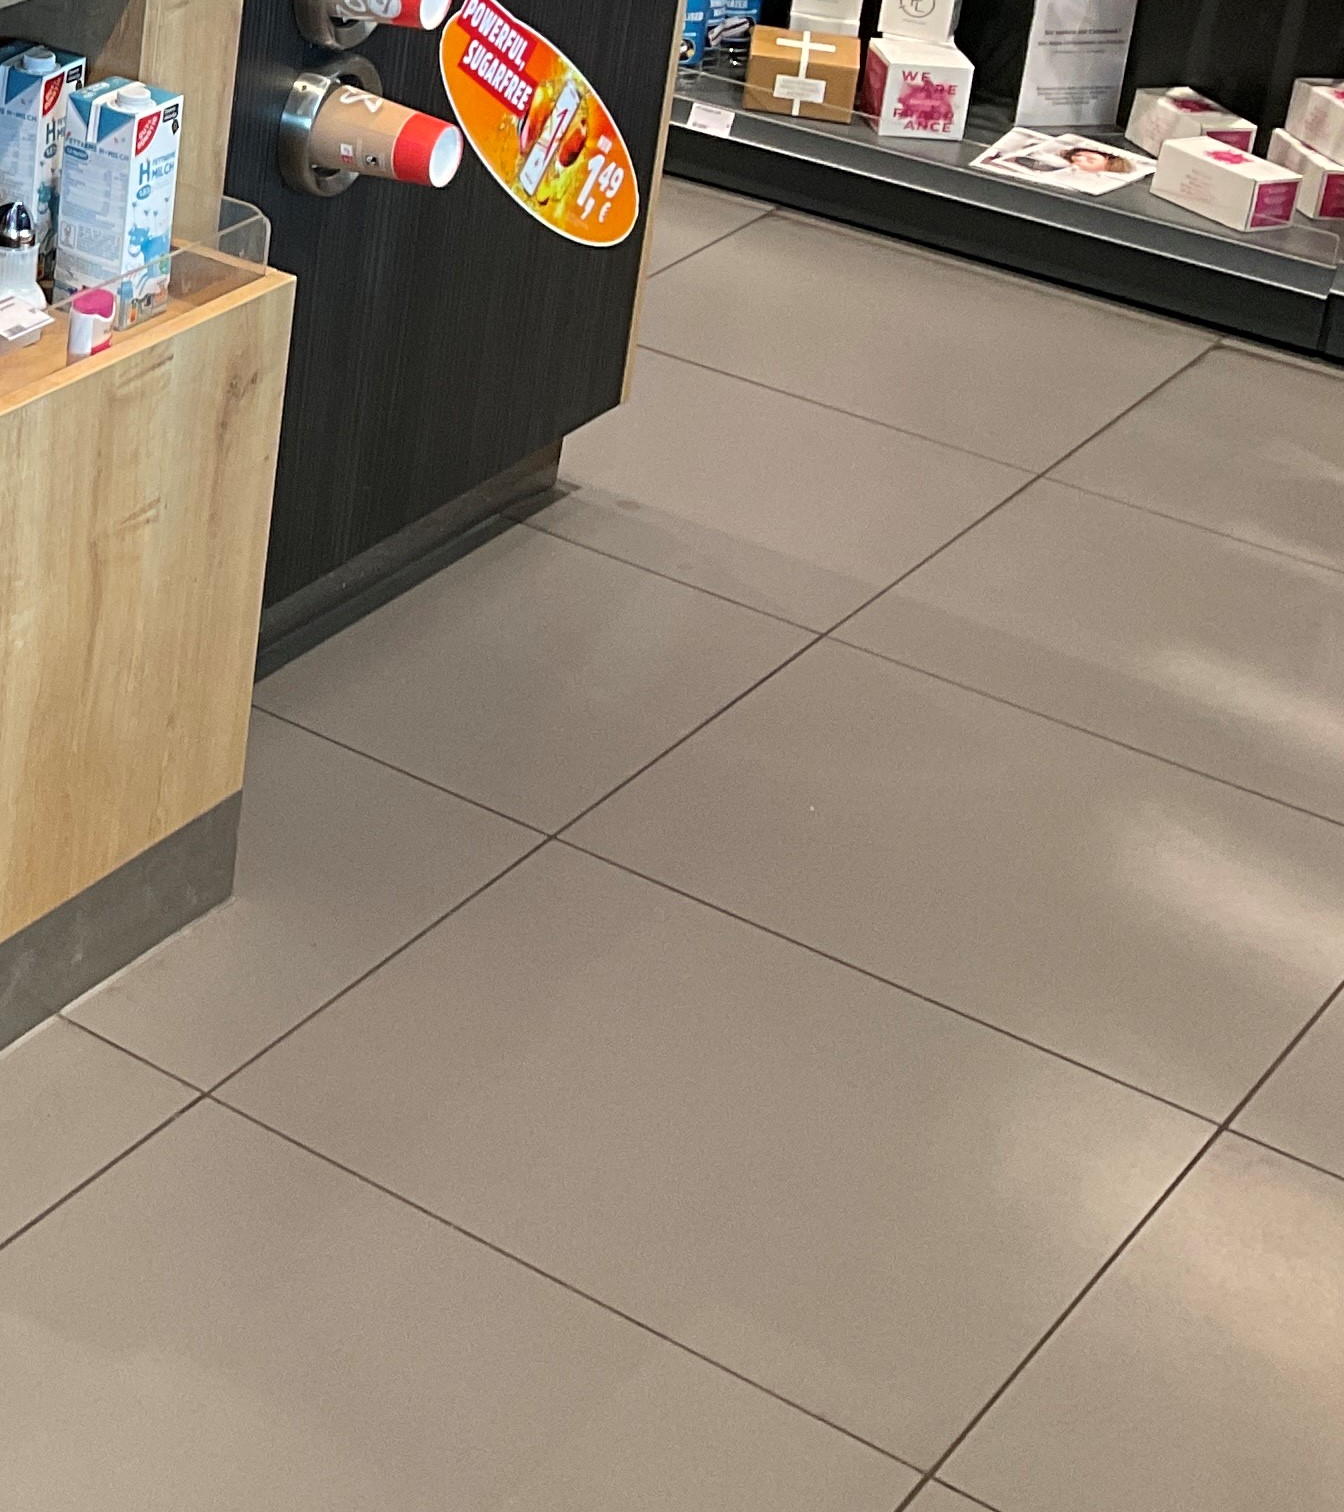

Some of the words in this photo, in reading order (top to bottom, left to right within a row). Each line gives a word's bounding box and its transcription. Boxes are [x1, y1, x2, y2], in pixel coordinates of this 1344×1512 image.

[465, 39, 533, 112] SUGARFREE
[902, 69, 932, 83] WE
[151, 162, 175, 181] MILCH
